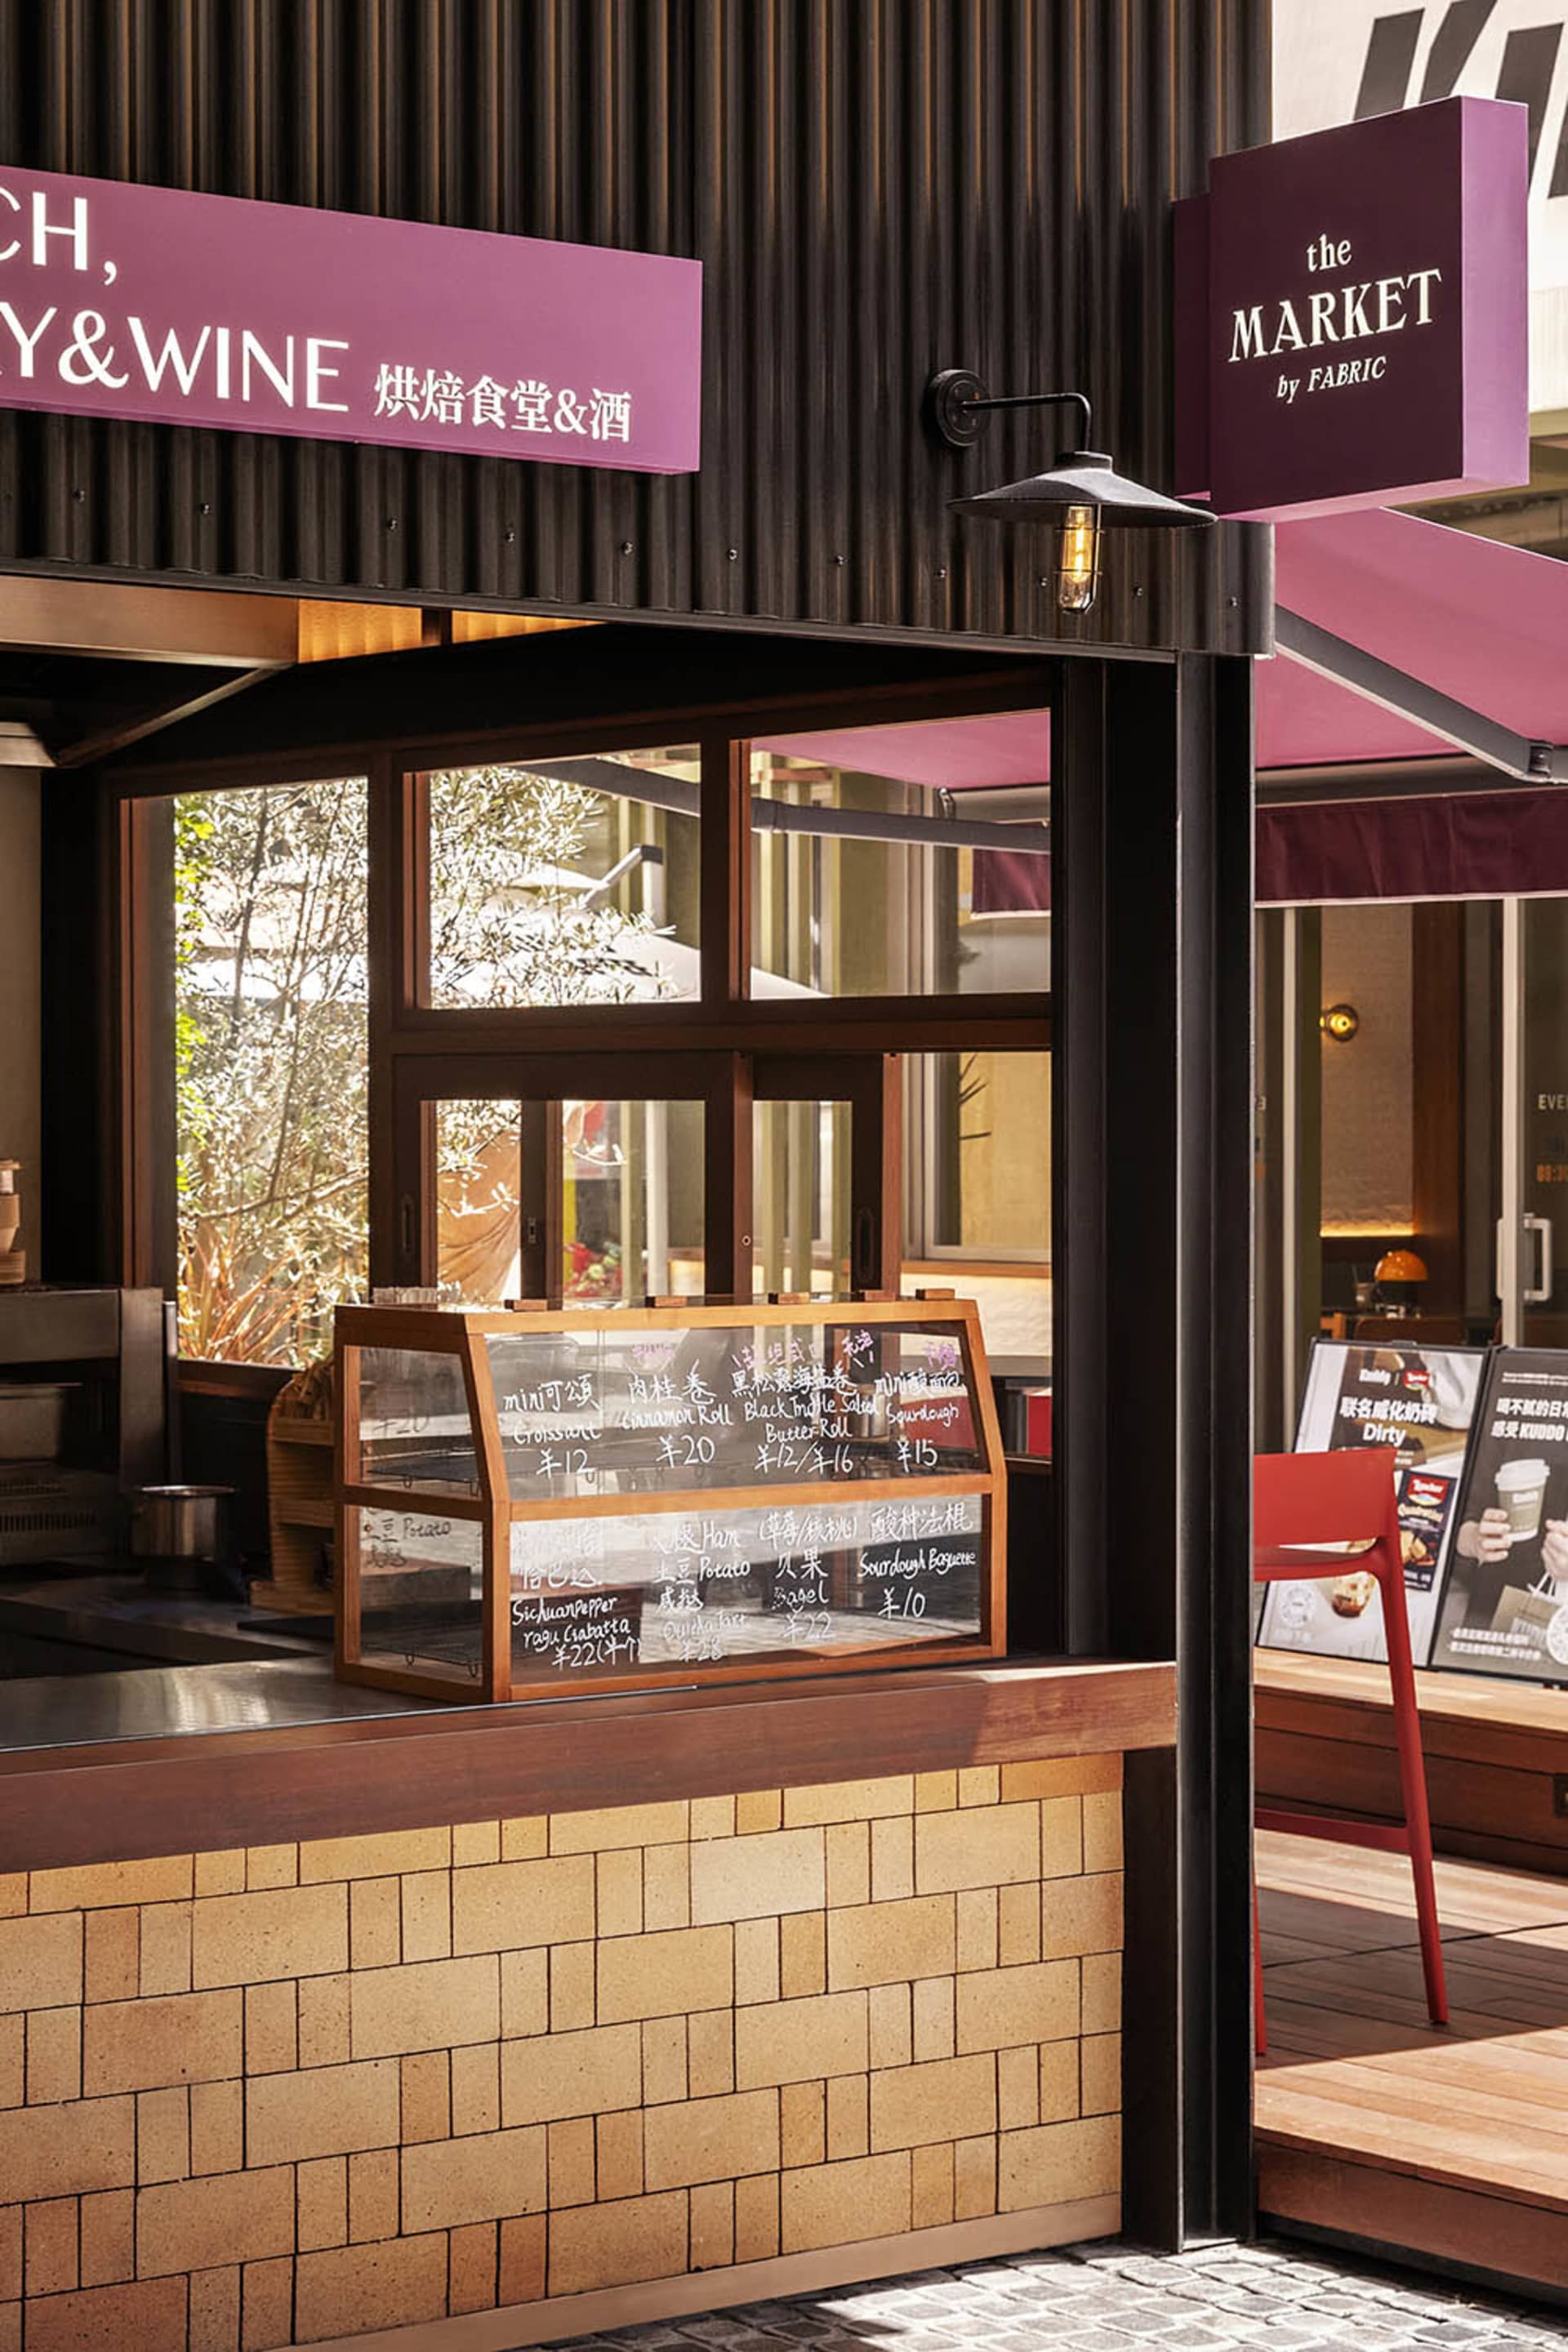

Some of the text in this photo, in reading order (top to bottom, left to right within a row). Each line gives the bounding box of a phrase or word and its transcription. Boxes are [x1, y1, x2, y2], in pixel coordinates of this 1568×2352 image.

[1307, 234, 1352, 273] the
[1228, 268, 1442, 363] MARKET
[0, 301, 633, 443] Y&WINE 烘焙食堂&酒
[1276, 355, 1387, 404] by FABRIC
[1538, 1094, 1568, 1111] EVE
[626, 1358, 718, 1405] 肉桂卷
[698, 1402, 735, 1427] Roll
[744, 1399, 793, 1422] Black
[818, 1417, 853, 1440] Roll
[1362, 1422, 1407, 1448] Dirty
[653, 1555, 751, 1585] 土豆 Potato
[775, 1548, 829, 1579] 贝果
[859, 1548, 925, 1579] Sourdough
